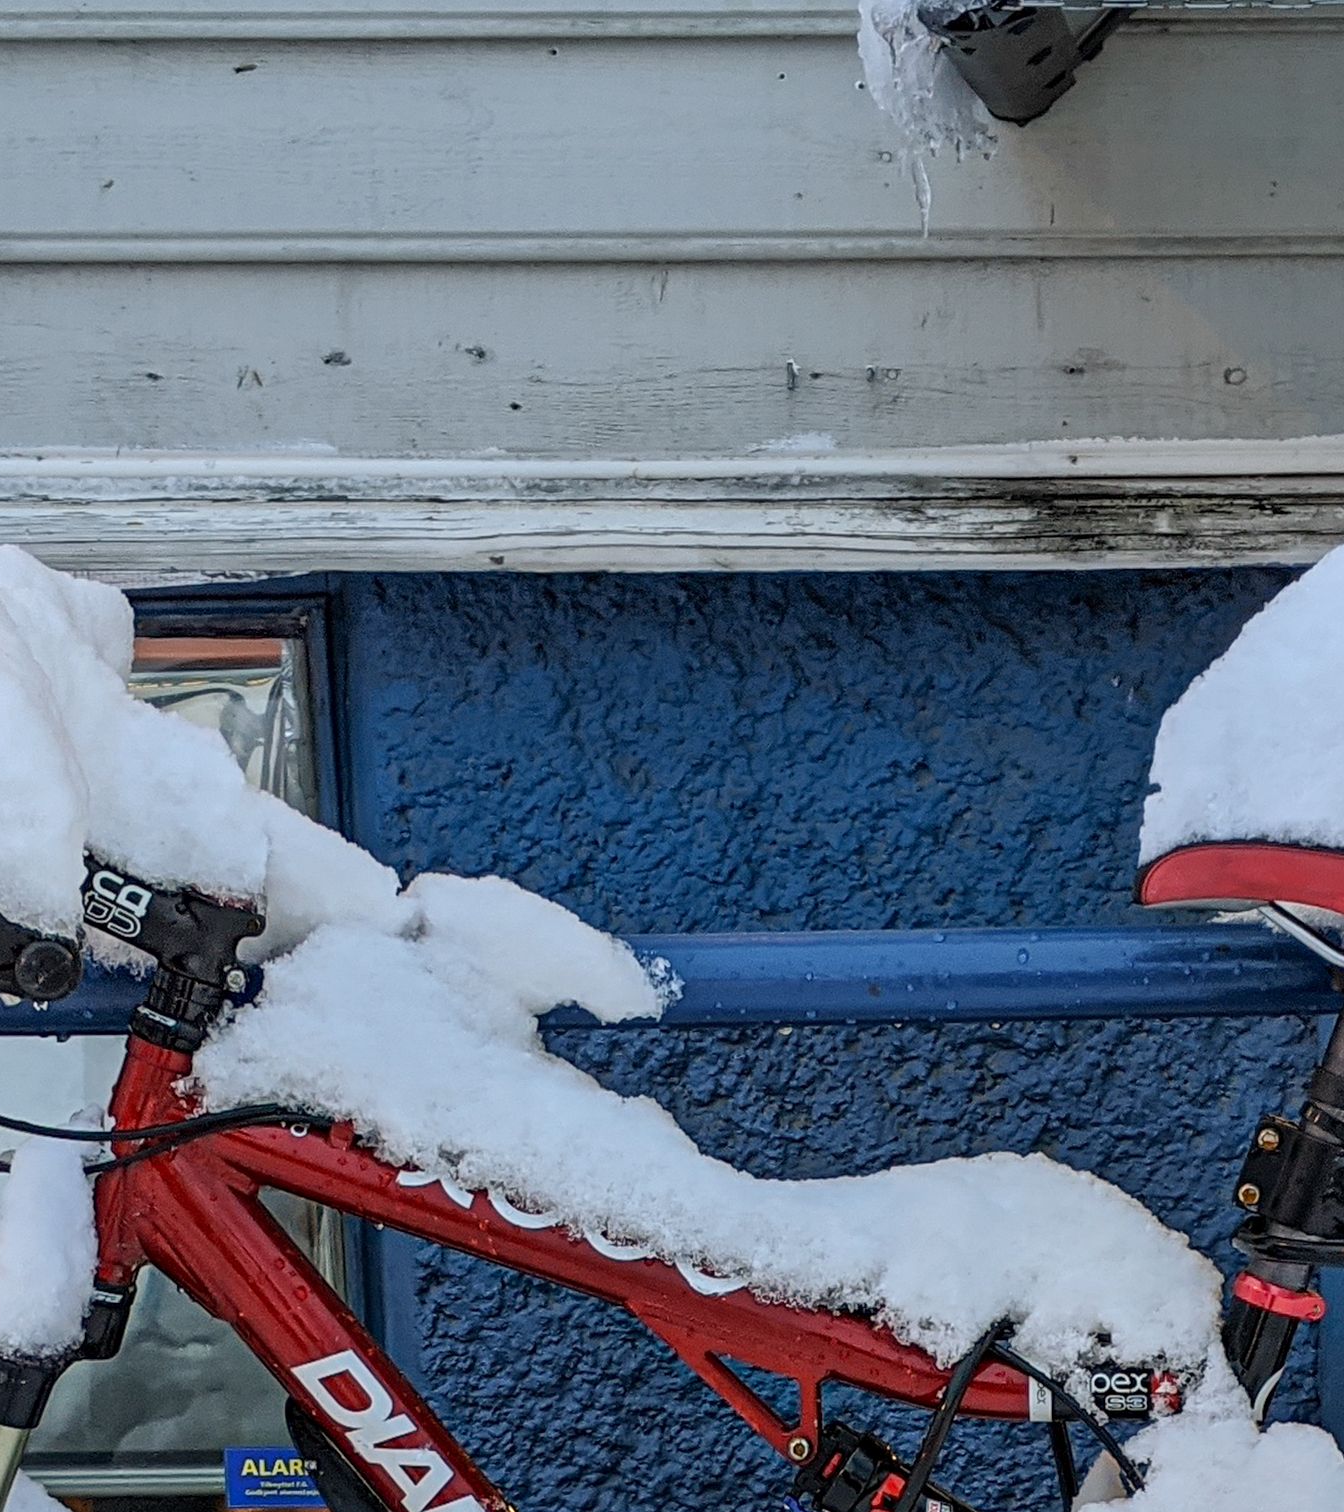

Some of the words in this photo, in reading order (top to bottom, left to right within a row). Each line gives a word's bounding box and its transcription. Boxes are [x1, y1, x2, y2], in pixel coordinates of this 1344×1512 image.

[1090, 1372, 1148, 1393] pex
[1105, 1394, 1148, 1411] S3
[240, 1458, 310, 1477] ALAR
